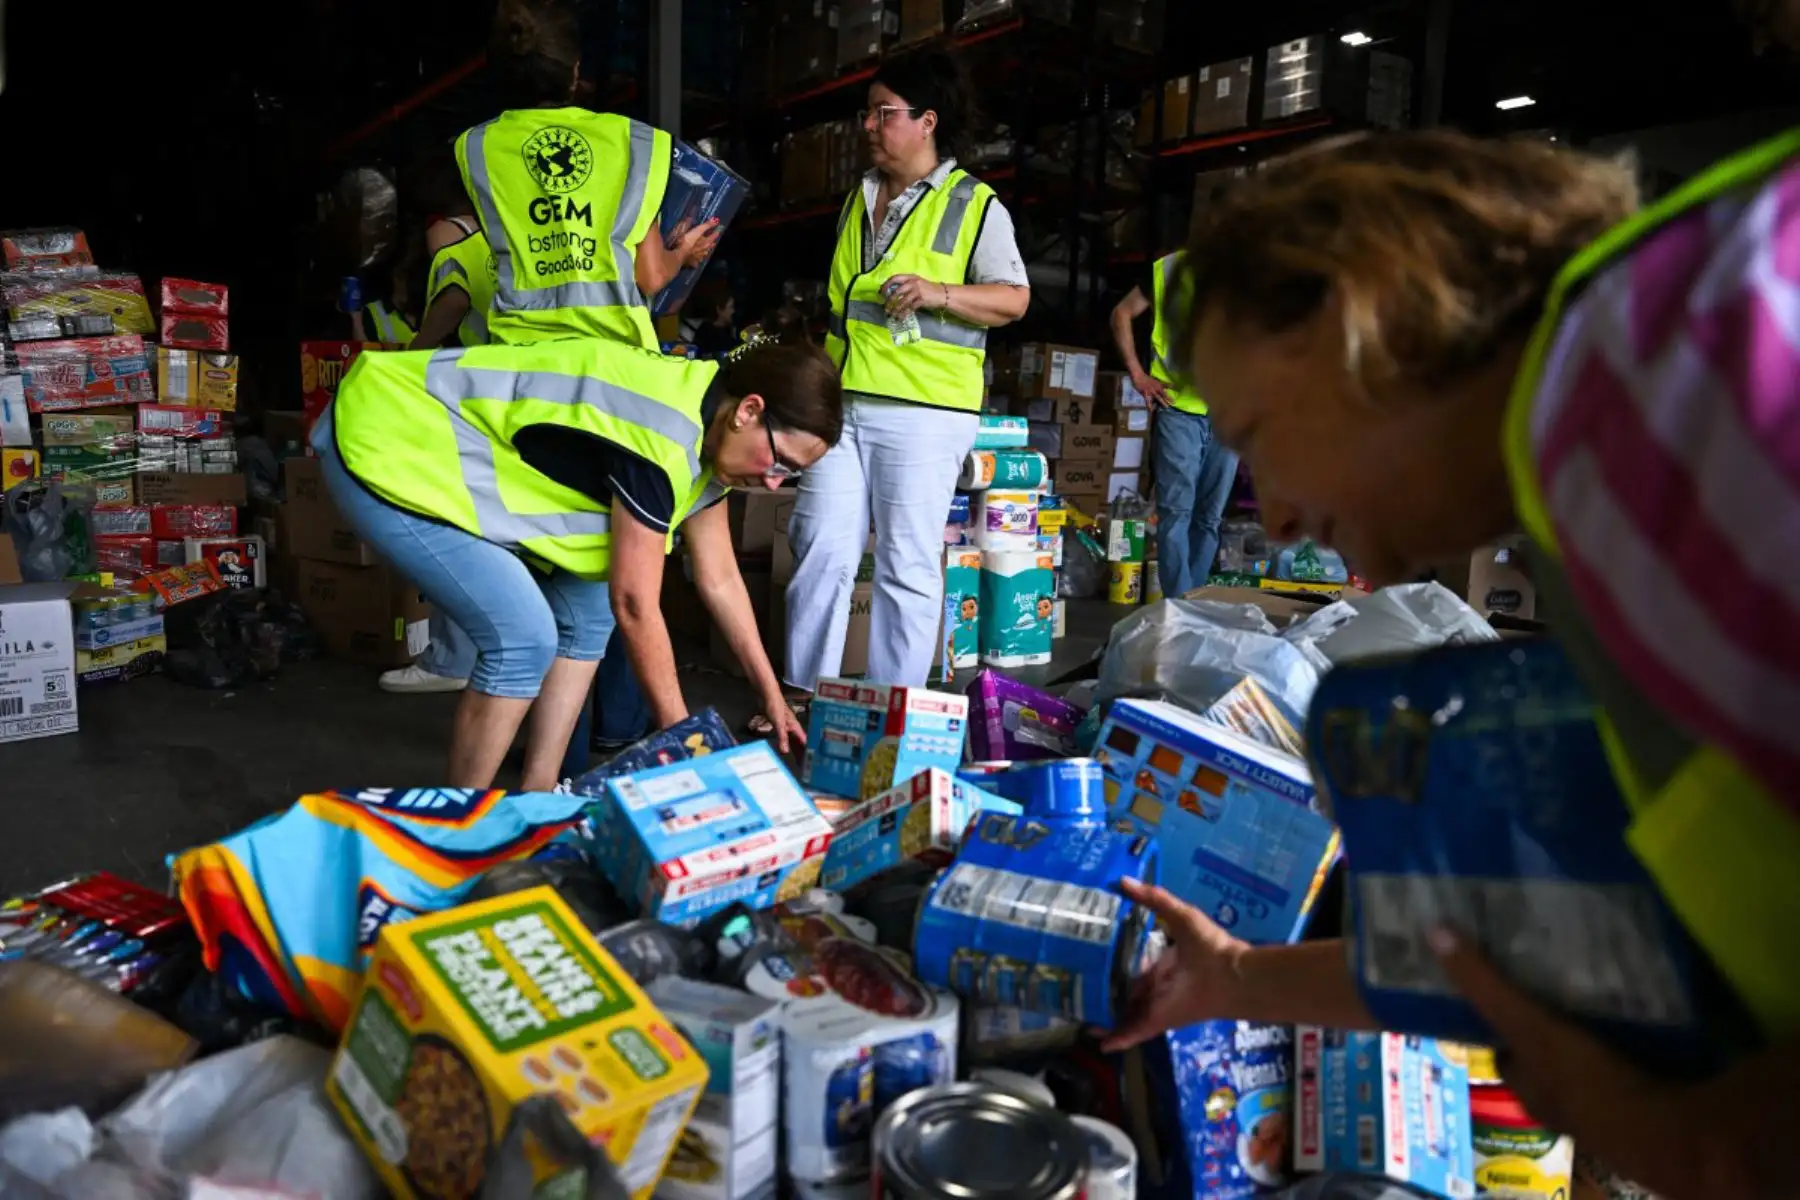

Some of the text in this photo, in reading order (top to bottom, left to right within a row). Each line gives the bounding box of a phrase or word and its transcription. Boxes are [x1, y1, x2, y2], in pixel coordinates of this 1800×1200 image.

[528, 194, 592, 228] GEM
[528, 230, 597, 257] bstrong
[1065, 471, 1094, 483] GOYA
[446, 928, 548, 1031] PLANT
